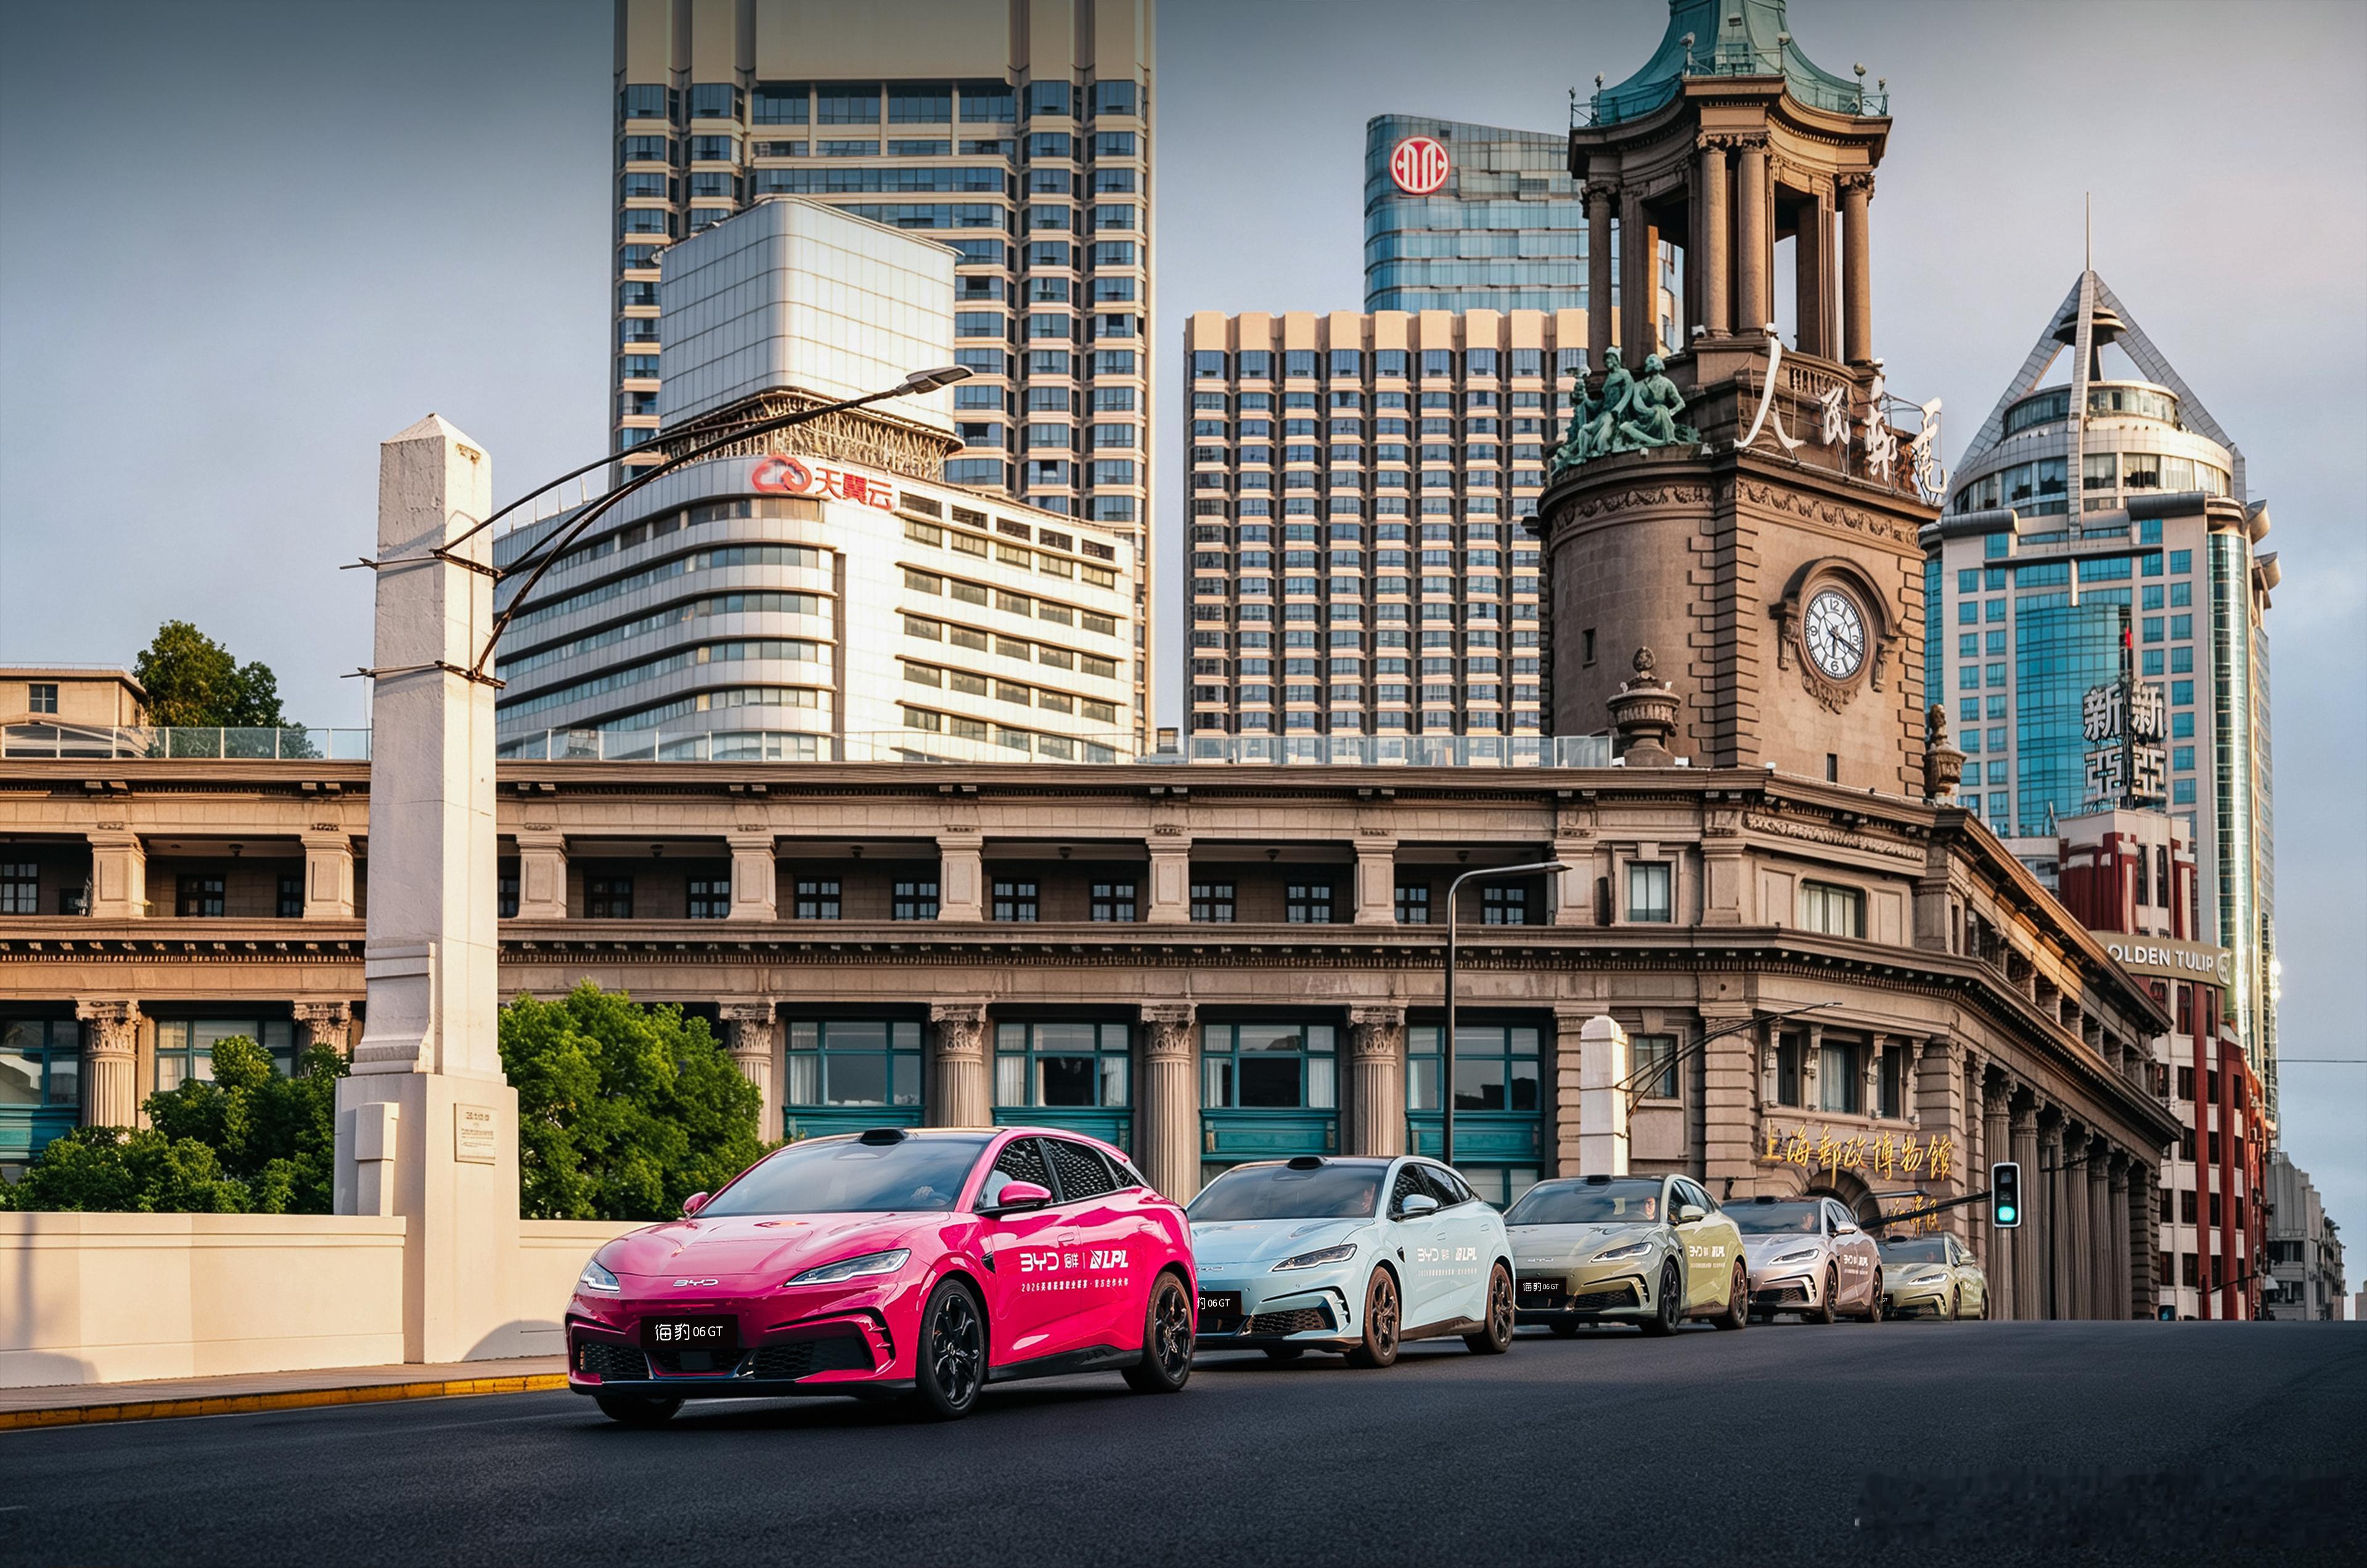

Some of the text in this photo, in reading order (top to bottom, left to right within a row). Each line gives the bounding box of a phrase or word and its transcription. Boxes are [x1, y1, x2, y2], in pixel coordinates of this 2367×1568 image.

[816, 467, 893, 511] 天翼云
[1829, 599, 1839, 611] 12
[1810, 626, 1818, 637] 9
[1852, 635, 1860, 646] 3
[1831, 661, 1839, 672] 6
[2107, 944, 2214, 973] OLDEN TULIP
[1417, 1248, 1439, 1262] BYD
[1020, 1252, 1059, 1272] BYD
[673, 1279, 719, 1287] BYD
[1523, 1283, 1542, 1292] 海豹
[1219, 1299, 1230, 1307] GT
[655, 1323, 723, 1341] 海豹 06 GT
